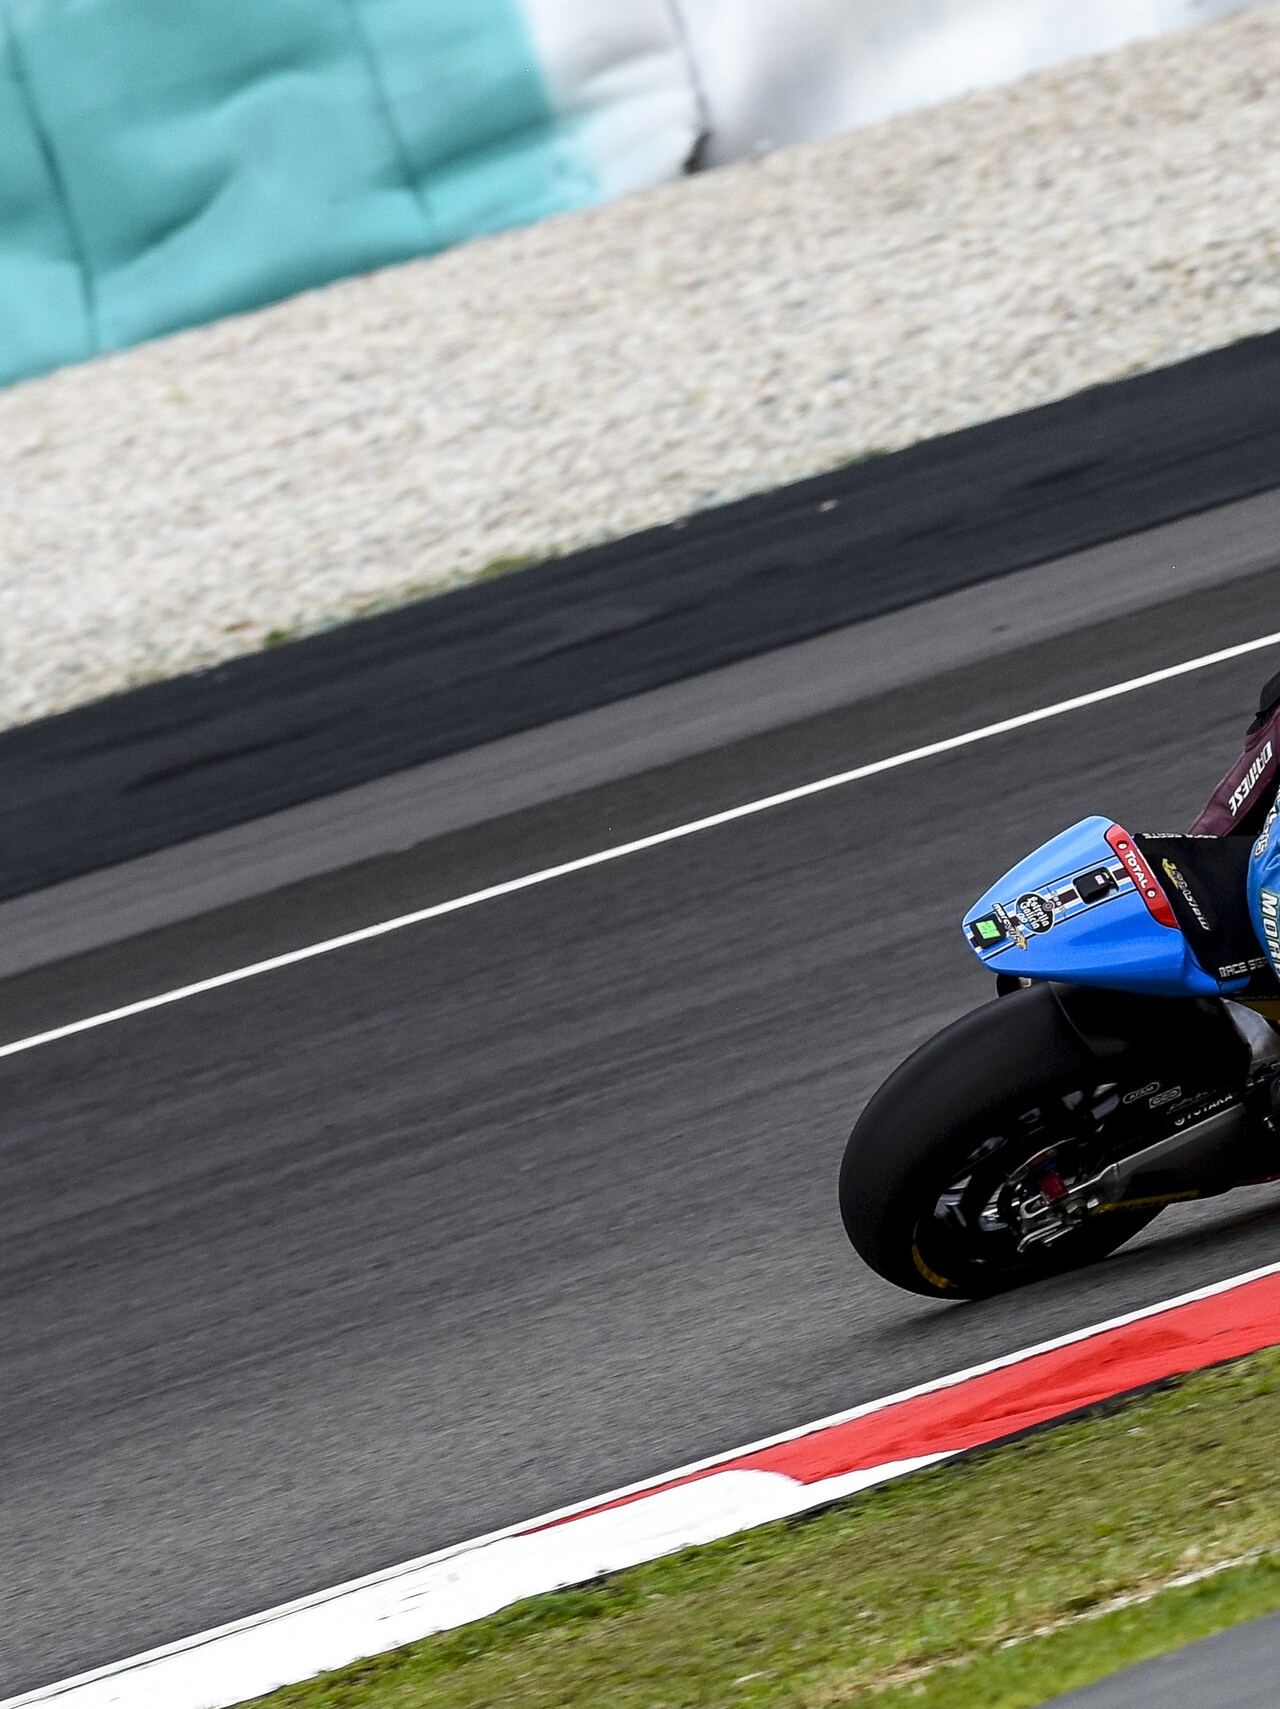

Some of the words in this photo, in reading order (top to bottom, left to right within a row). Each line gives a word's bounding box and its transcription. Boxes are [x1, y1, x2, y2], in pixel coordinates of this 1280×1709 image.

[1124, 850, 1148, 889] TOTAL
[1020, 901, 1041, 930] Galicia
[1028, 896, 1050, 928] Estrella
